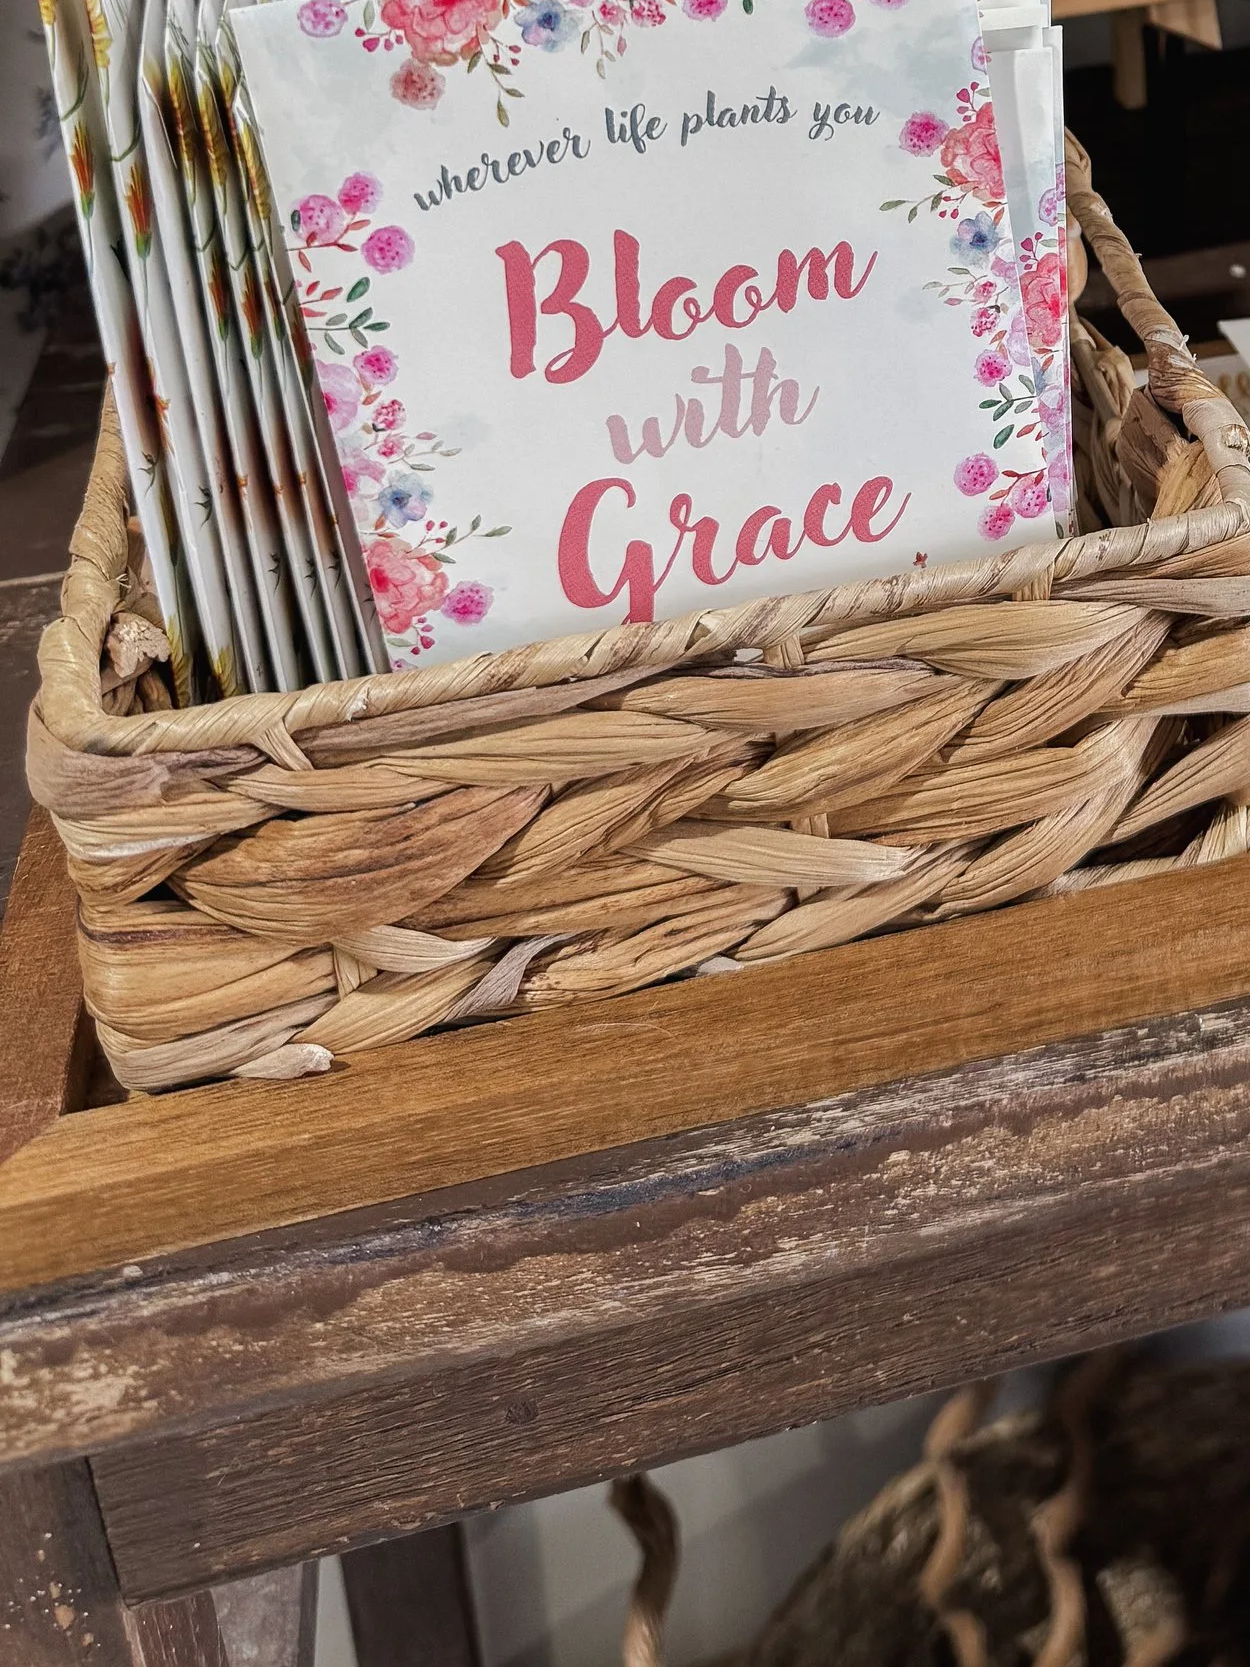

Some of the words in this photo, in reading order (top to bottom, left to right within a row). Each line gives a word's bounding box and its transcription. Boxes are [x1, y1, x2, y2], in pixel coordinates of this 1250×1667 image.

[413, 127, 592, 212] wherever
[605, 103, 668, 154] life
[680, 86, 798, 147] plants
[808, 99, 881, 141] you
[495, 228, 878, 384] Bloom
[605, 342, 820, 465] with
[557, 475, 912, 625] Grace
